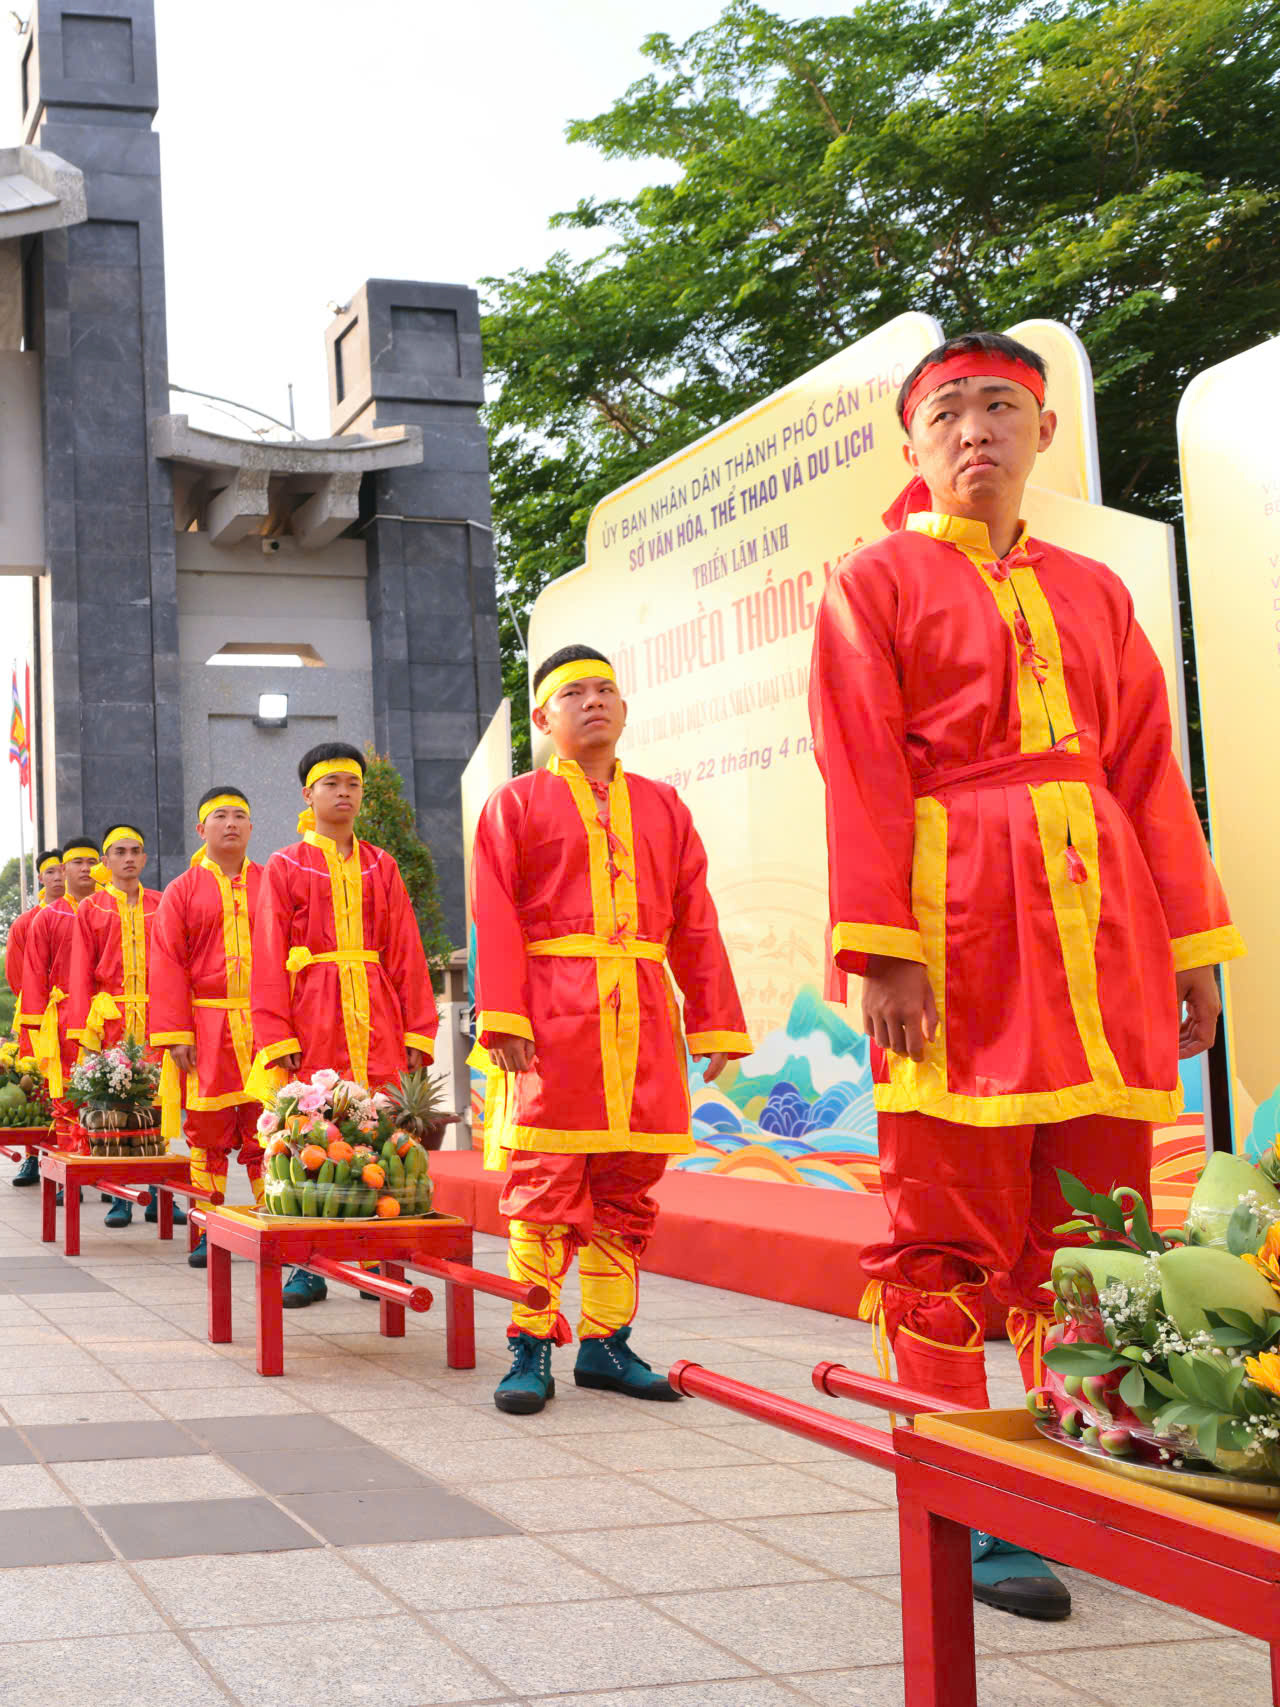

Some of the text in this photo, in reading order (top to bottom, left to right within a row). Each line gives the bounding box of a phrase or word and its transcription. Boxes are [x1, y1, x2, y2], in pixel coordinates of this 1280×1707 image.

[602, 520, 617, 549] ỦY
[622, 507, 647, 539] BAN
[651, 484, 687, 523] NHÂN
[692, 466, 721, 501] DÂN
[725, 442, 777, 481] THÀNH
[783, 400, 817, 450] PHỐ
[823, 384, 859, 427] CẦN
[629, 422, 874, 572] SỞ VĂN HÓA, THỂ THAO VÀ DU LỊCH
[762, 525, 789, 560] ẢNH
[643, 600, 725, 689] TRUYỀN
[732, 567, 815, 655] THỐNG
[696, 757, 716, 782] 22
[720, 746, 773, 775] tháng
[779, 736, 790, 758] 4
